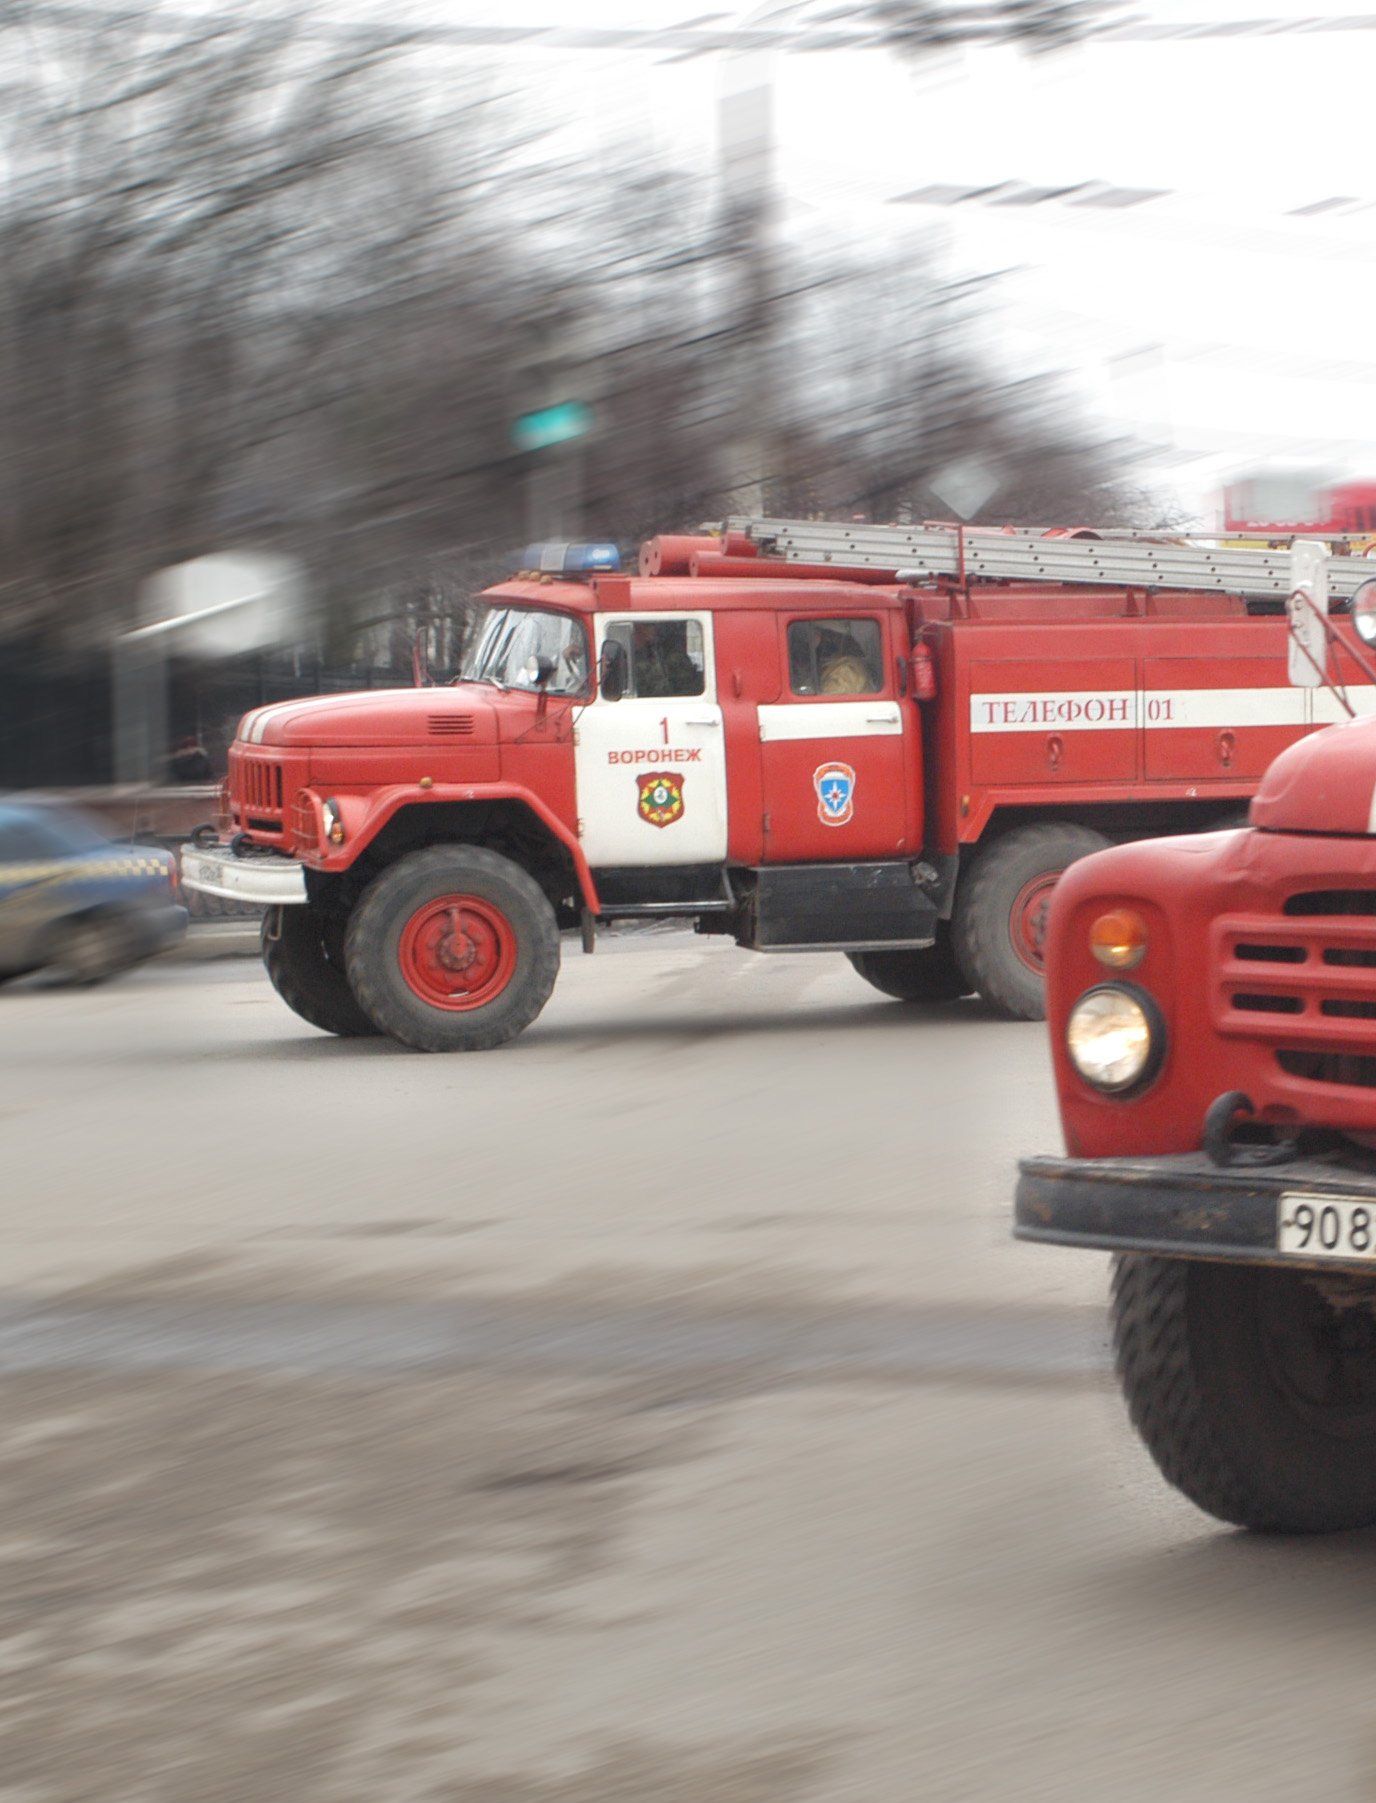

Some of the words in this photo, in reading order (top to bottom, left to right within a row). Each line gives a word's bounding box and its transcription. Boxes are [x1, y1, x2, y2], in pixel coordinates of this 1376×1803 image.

[982, 698, 1129, 724] ТЕЛЕФОН
[1147, 698, 1174, 720] 01
[659, 716, 669, 745] 1
[607, 748, 702, 765] ВОРОНЕЖ
